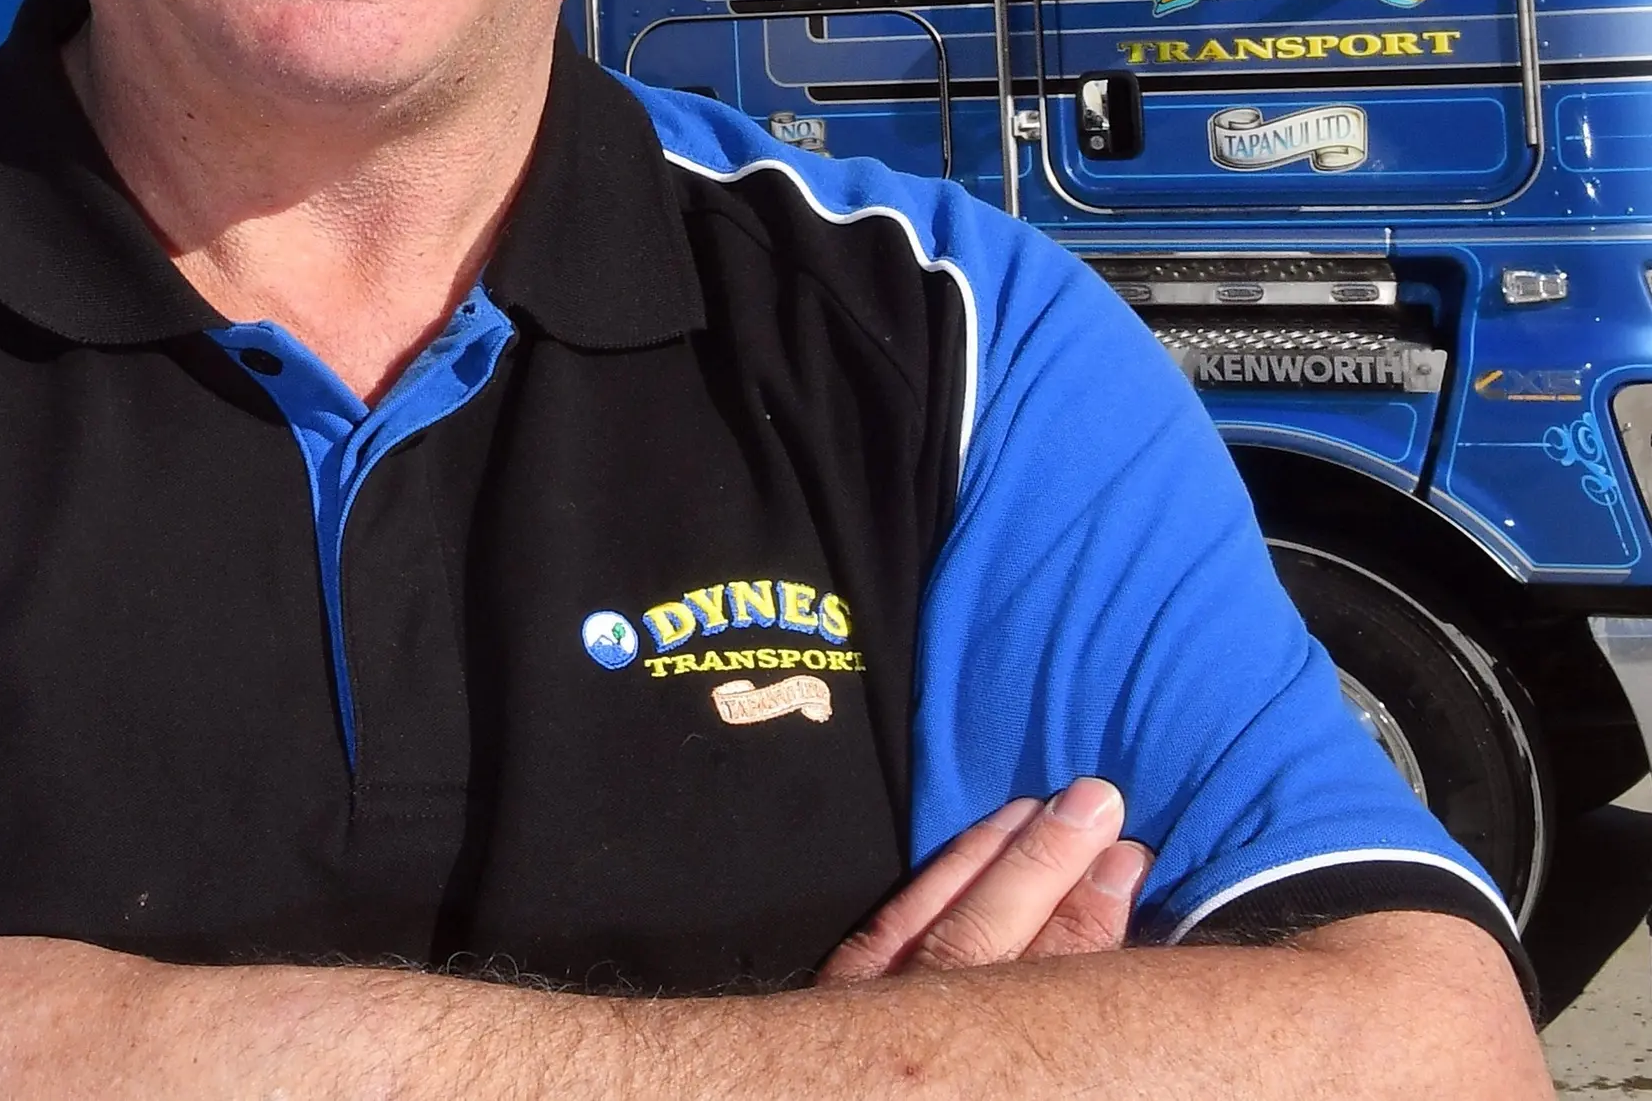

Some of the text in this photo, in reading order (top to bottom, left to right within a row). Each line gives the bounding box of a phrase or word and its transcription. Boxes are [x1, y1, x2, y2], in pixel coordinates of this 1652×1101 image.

[1117, 30, 1461, 65] TRANSPORT
[1224, 113, 1357, 159] TAPANUI LTD.
[1199, 353, 1403, 385] KENWORTH
[641, 580, 852, 653] DYNES
[644, 648, 867, 678] TRANSPORT
